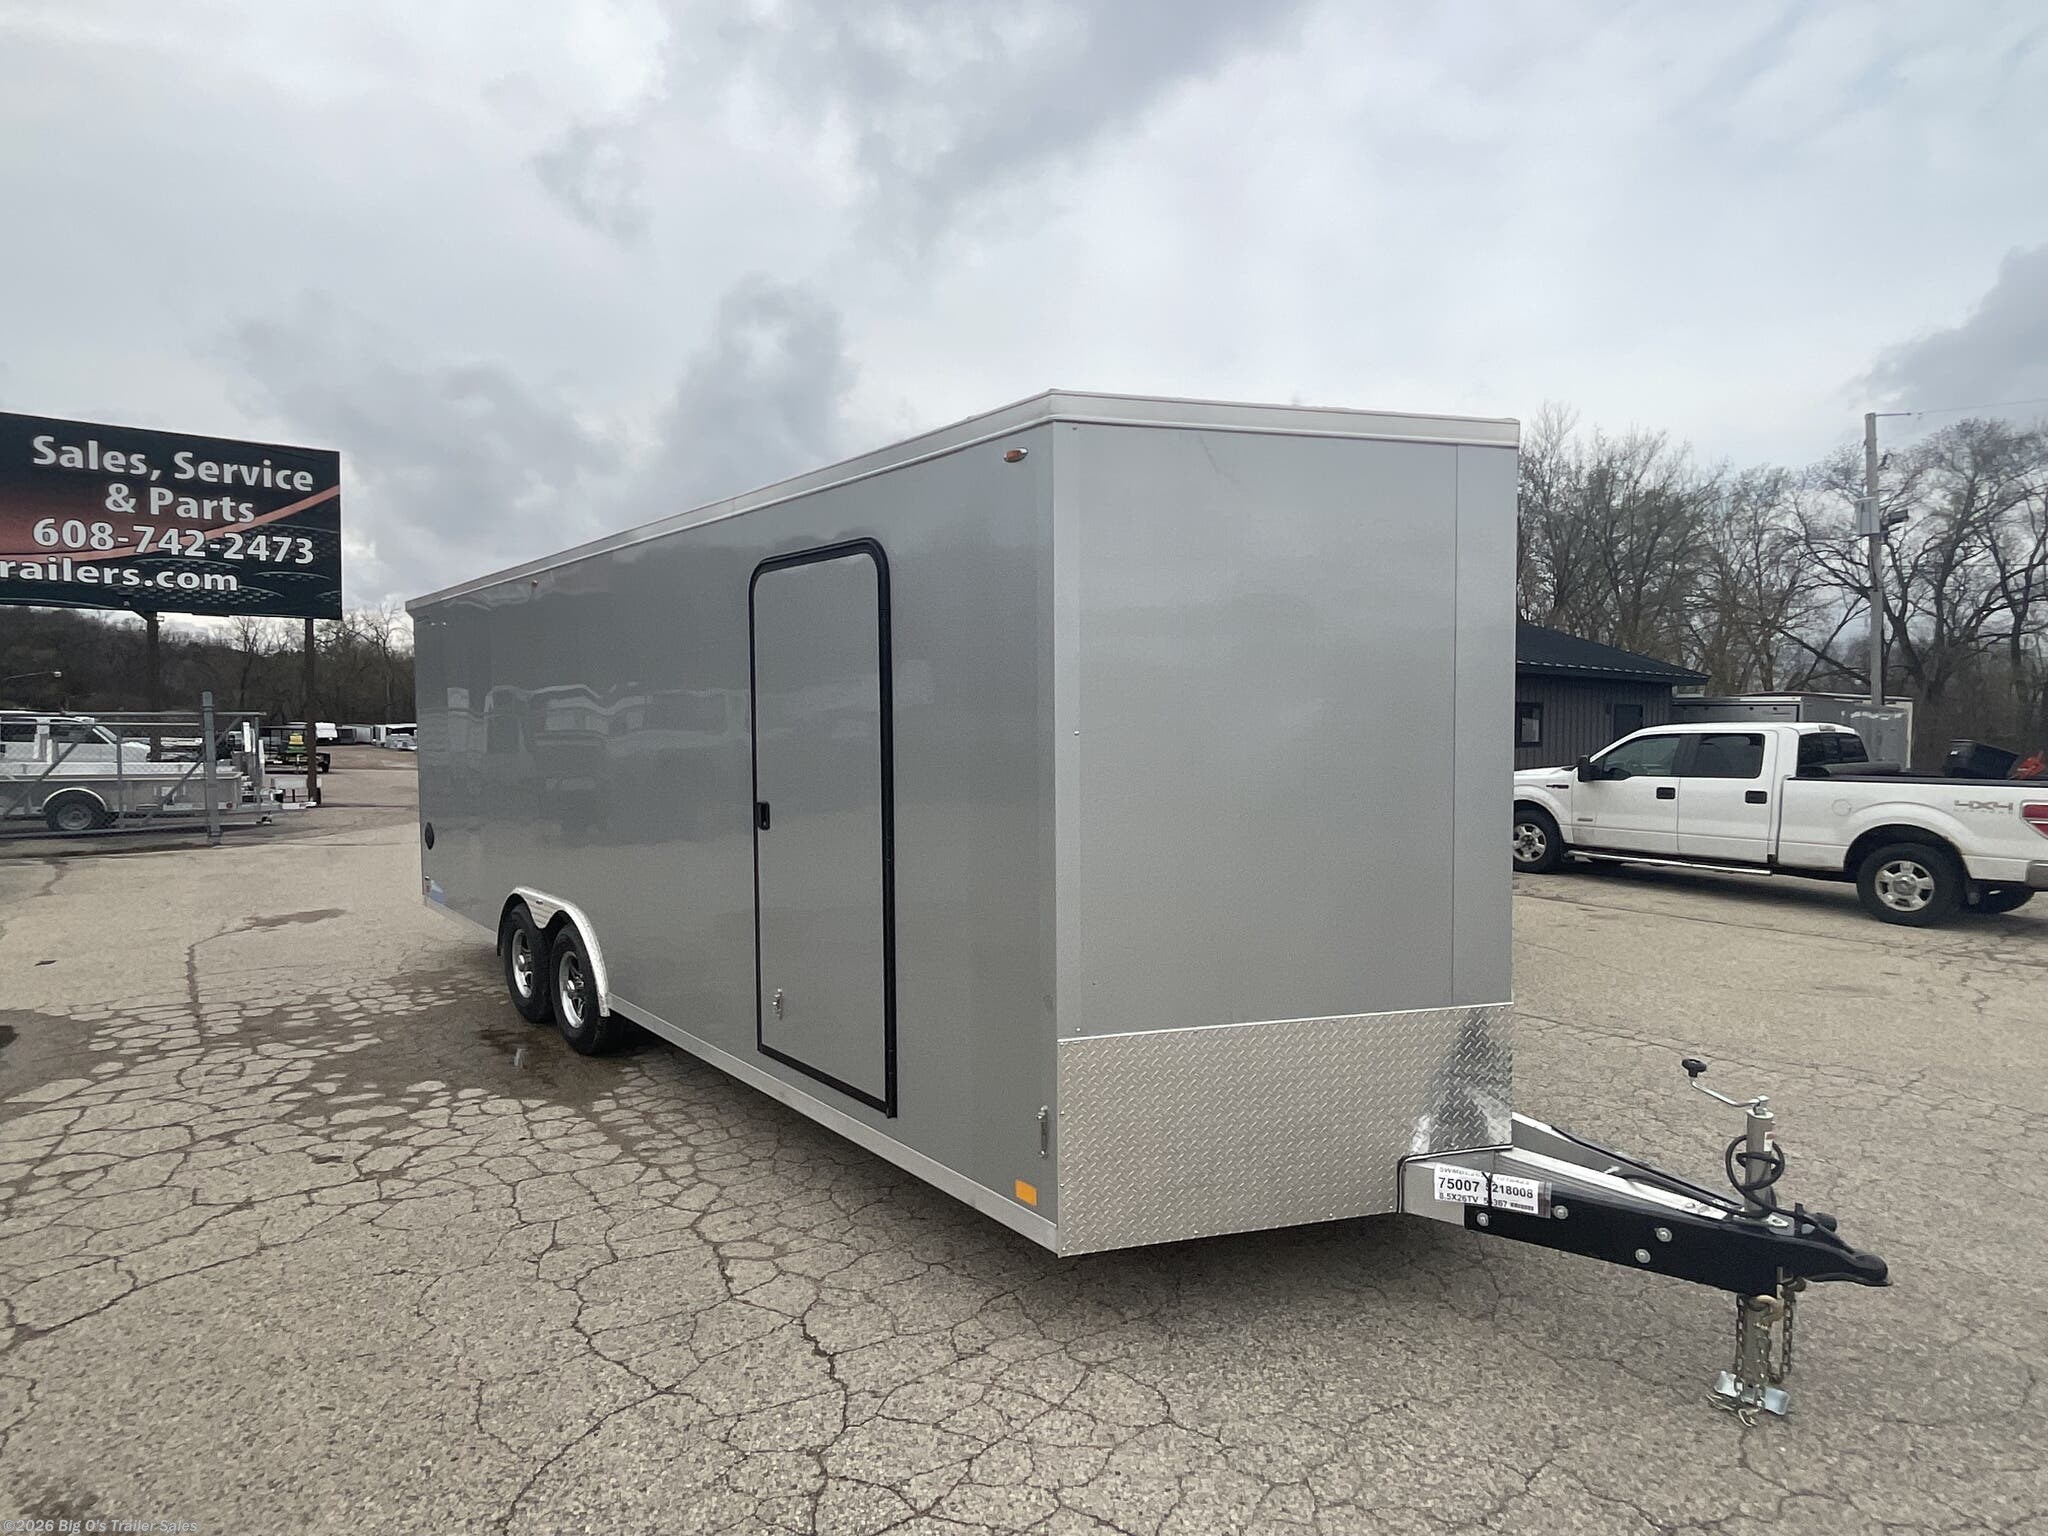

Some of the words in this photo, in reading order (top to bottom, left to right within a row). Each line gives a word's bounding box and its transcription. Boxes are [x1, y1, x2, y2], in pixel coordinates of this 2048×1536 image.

[32, 435, 161, 481] Sales,
[173, 451, 314, 492] Service
[104, 483, 137, 514] &
[150, 487, 256, 523] Parts
[32, 518, 315, 564] 608-742-2473
[0, 556, 239, 591] railers.com
[1438, 1176, 1480, 1193] 75007
